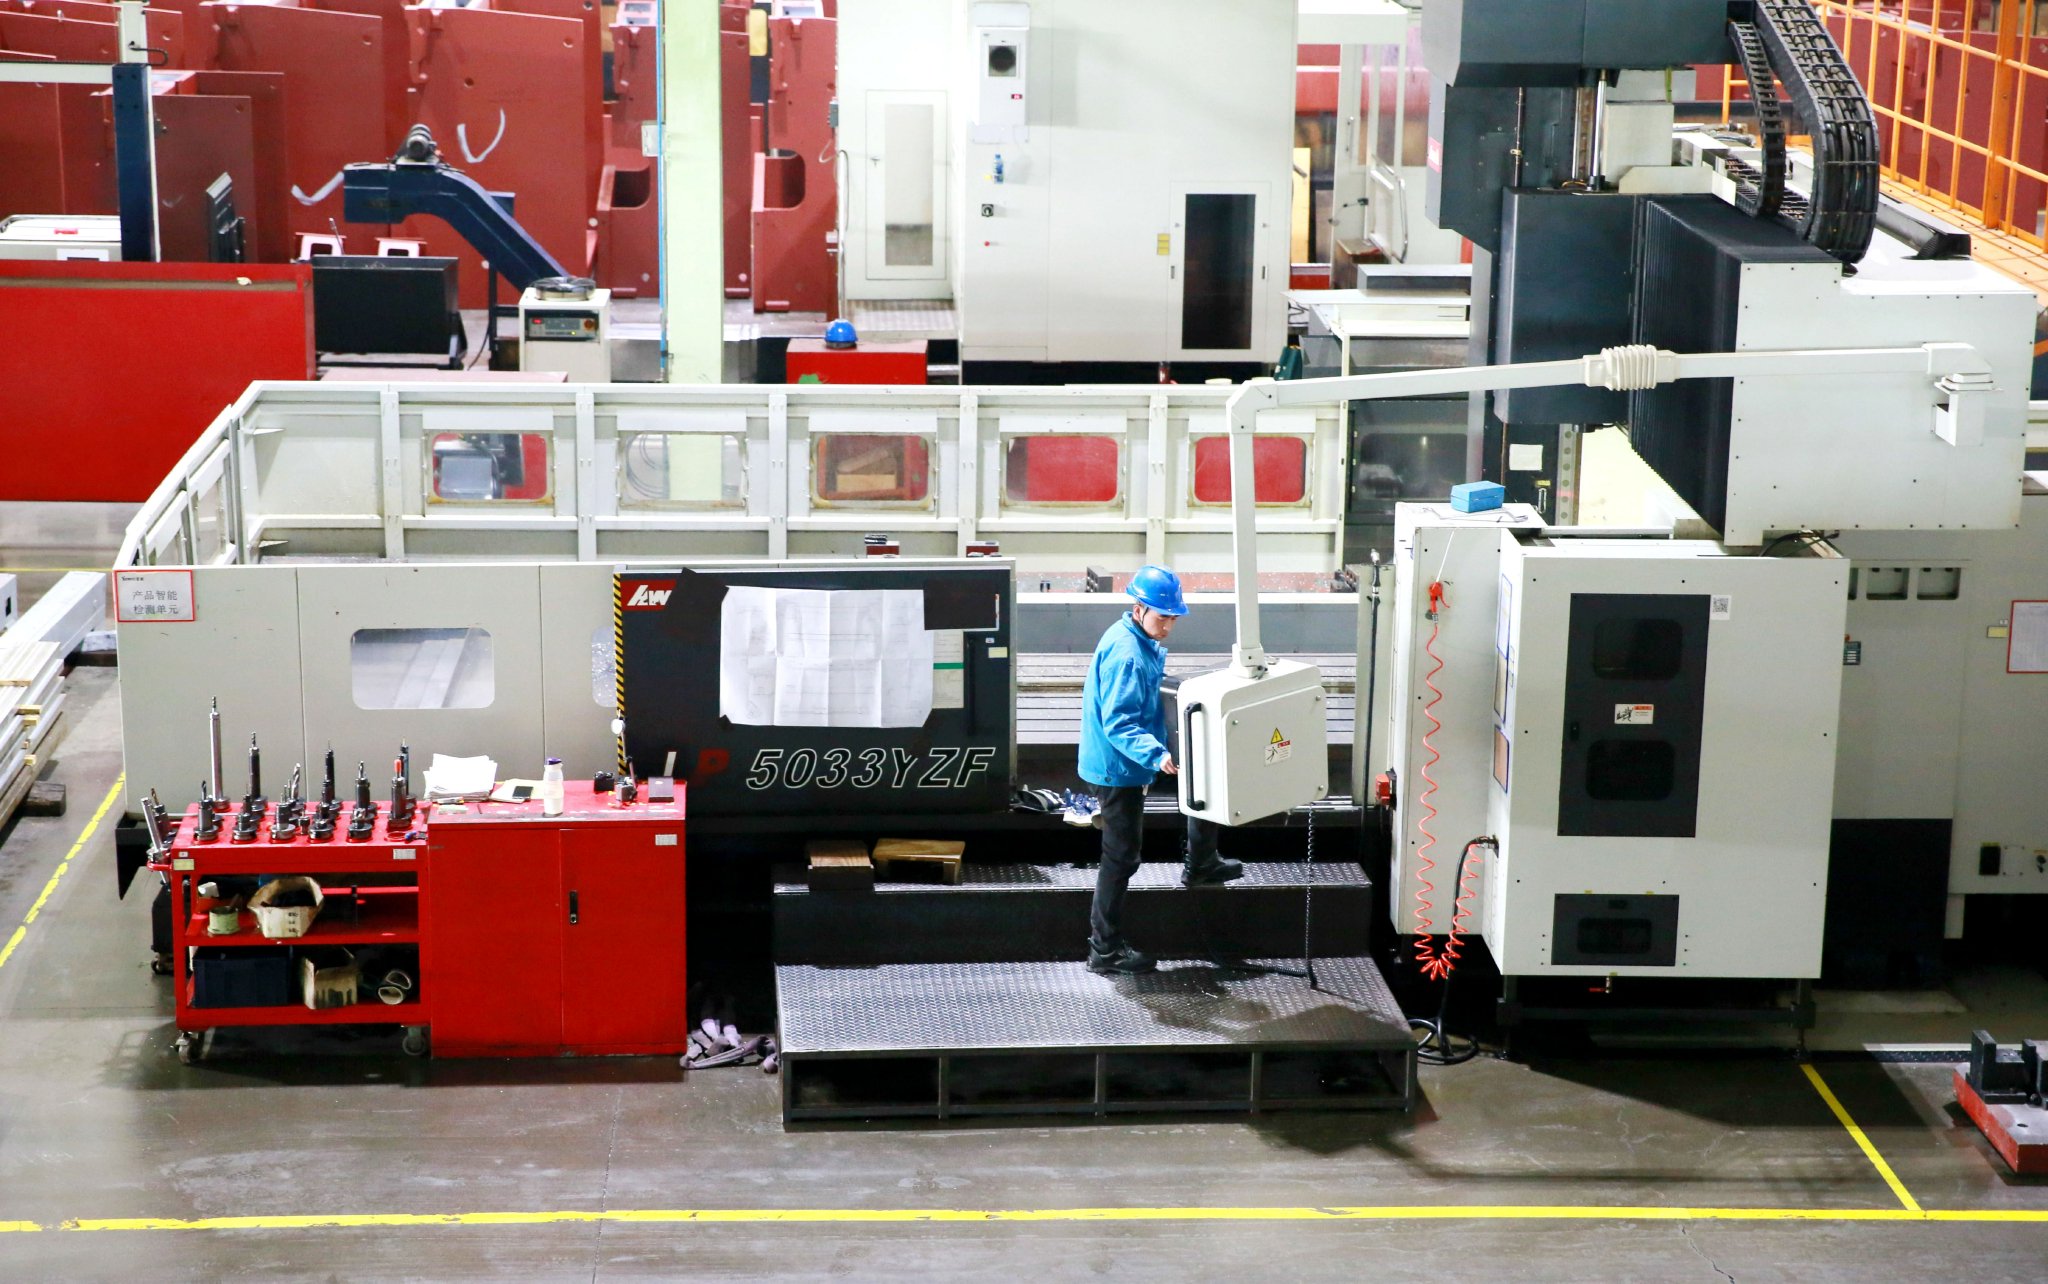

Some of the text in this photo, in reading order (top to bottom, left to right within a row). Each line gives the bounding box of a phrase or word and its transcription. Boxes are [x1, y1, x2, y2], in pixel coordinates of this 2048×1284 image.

[133, 590, 178, 601] 产品智能
[133, 604, 179, 615] 检测单元
[745, 746, 997, 790] 5033YZF
